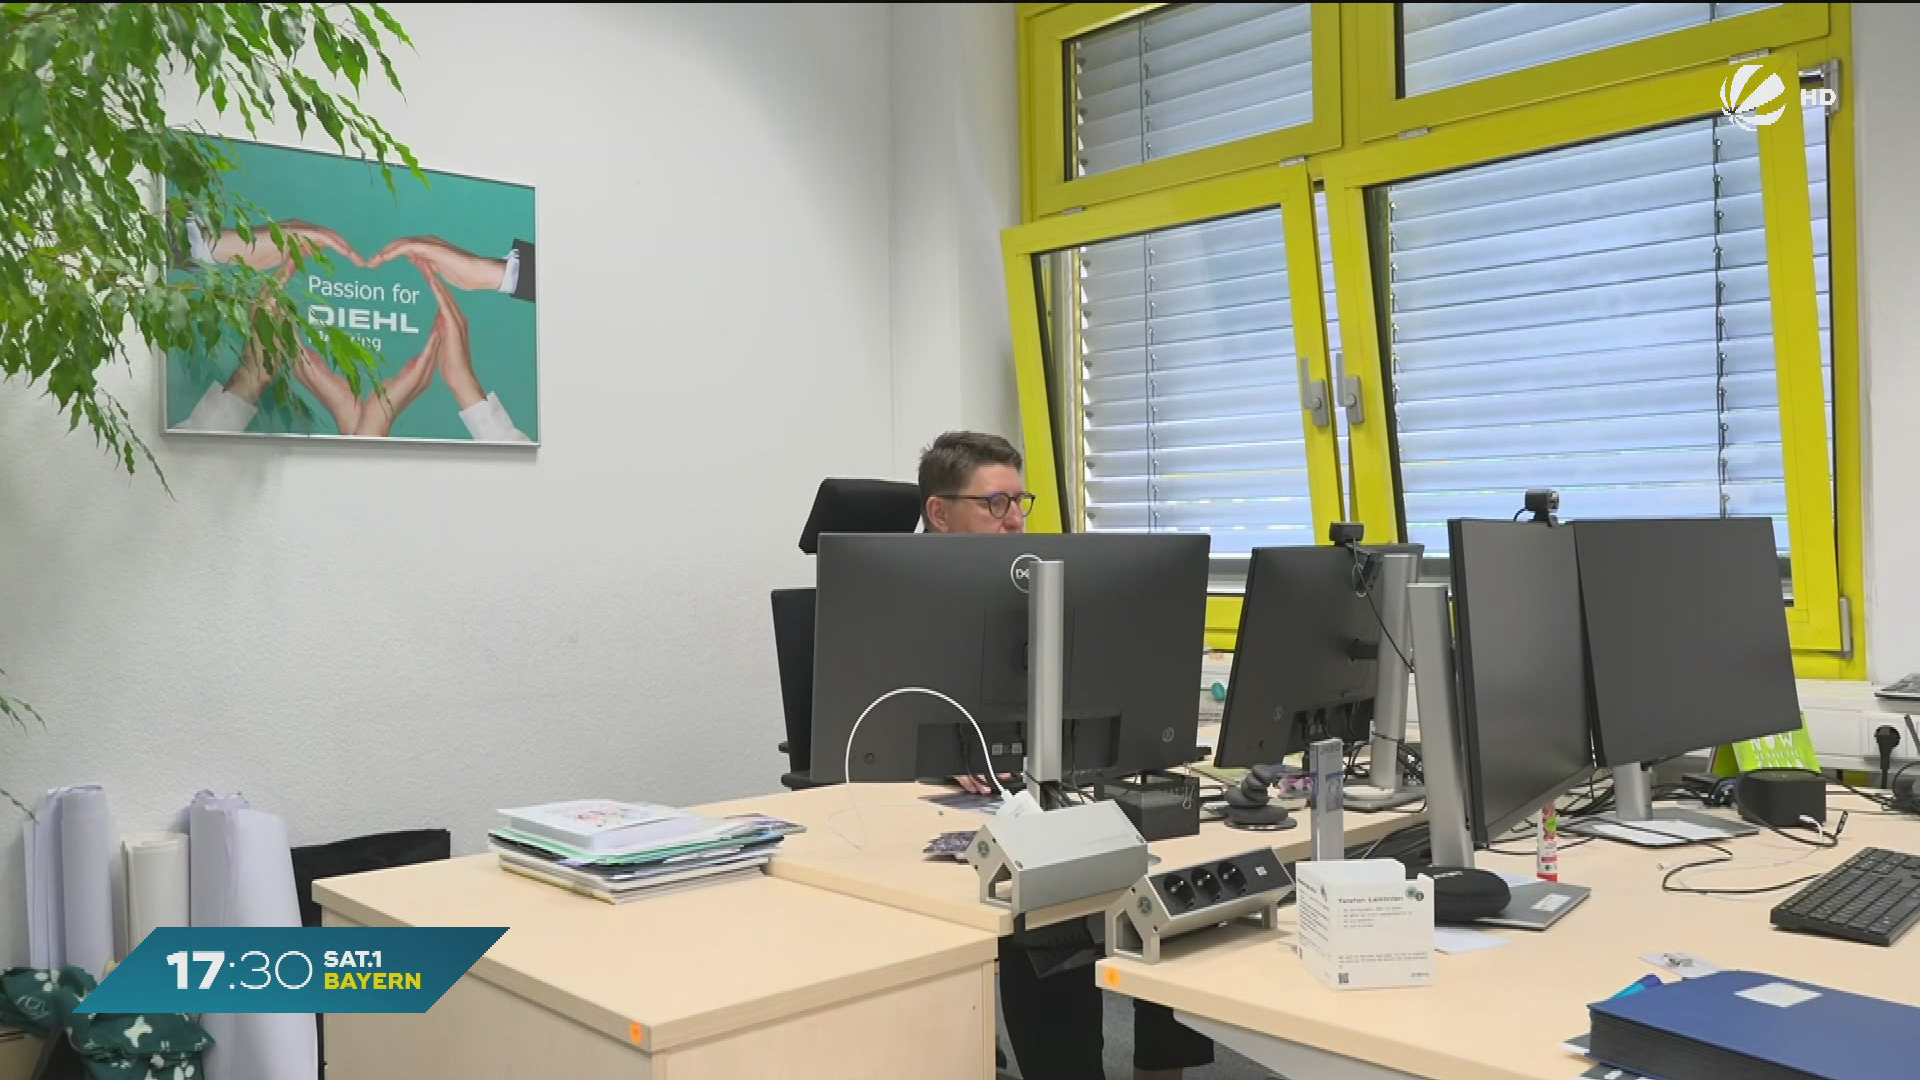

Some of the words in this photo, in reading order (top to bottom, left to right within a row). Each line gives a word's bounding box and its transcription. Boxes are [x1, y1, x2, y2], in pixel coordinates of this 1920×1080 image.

[308, 274, 385, 302] Passion
[392, 283, 421, 304] for
[308, 304, 420, 334] DIEHL
